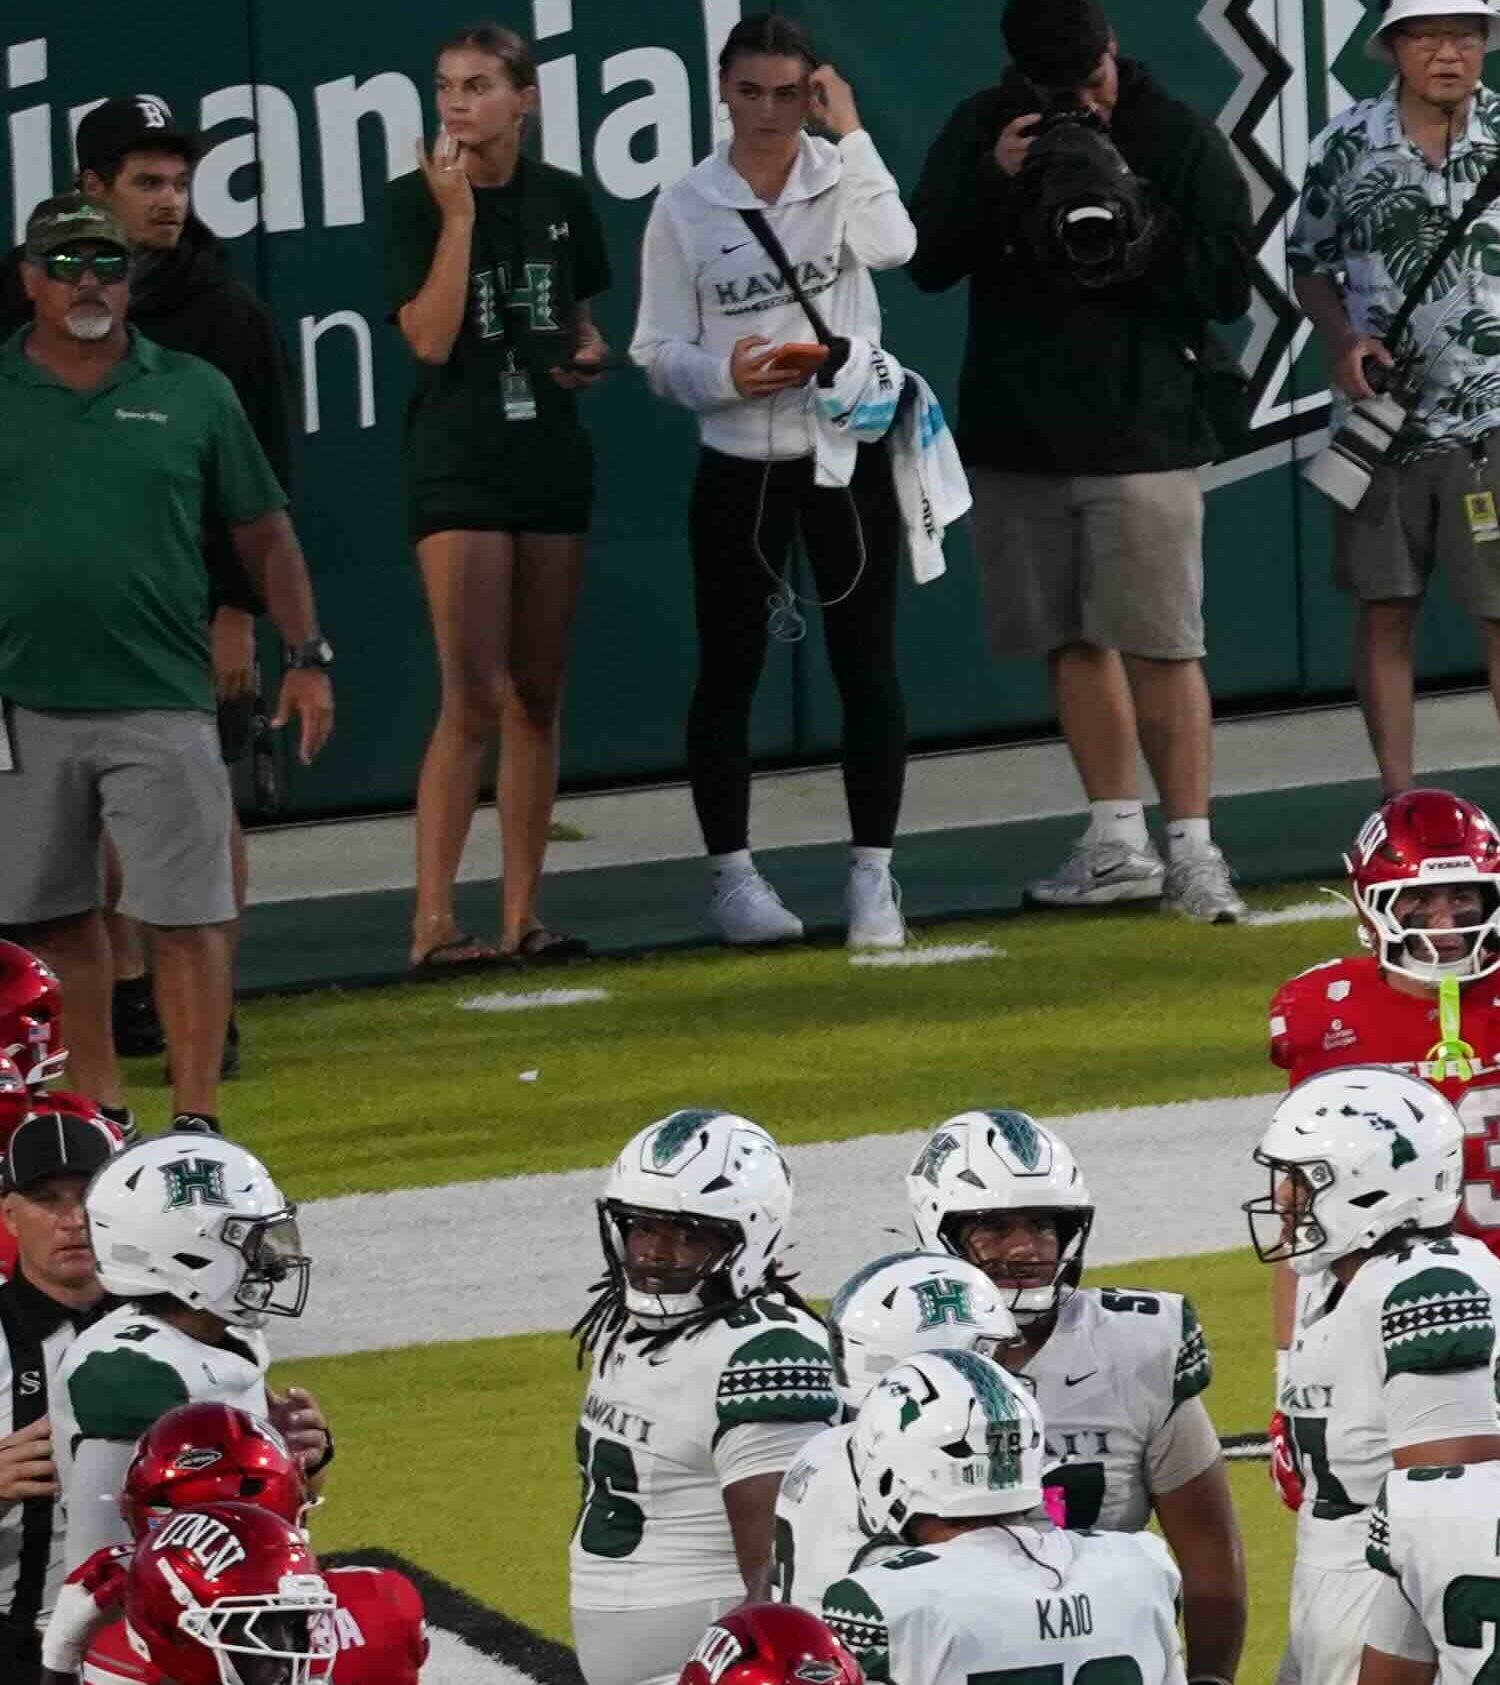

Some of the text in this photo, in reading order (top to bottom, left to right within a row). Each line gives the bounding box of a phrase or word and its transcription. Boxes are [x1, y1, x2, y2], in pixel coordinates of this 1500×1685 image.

[136, 102, 166, 128] B
[158, 1158, 236, 1213] H
[910, 1277, 977, 1333] H
[152, 1513, 246, 1582] UNLV
[1035, 1594, 1094, 1640] KAIO
